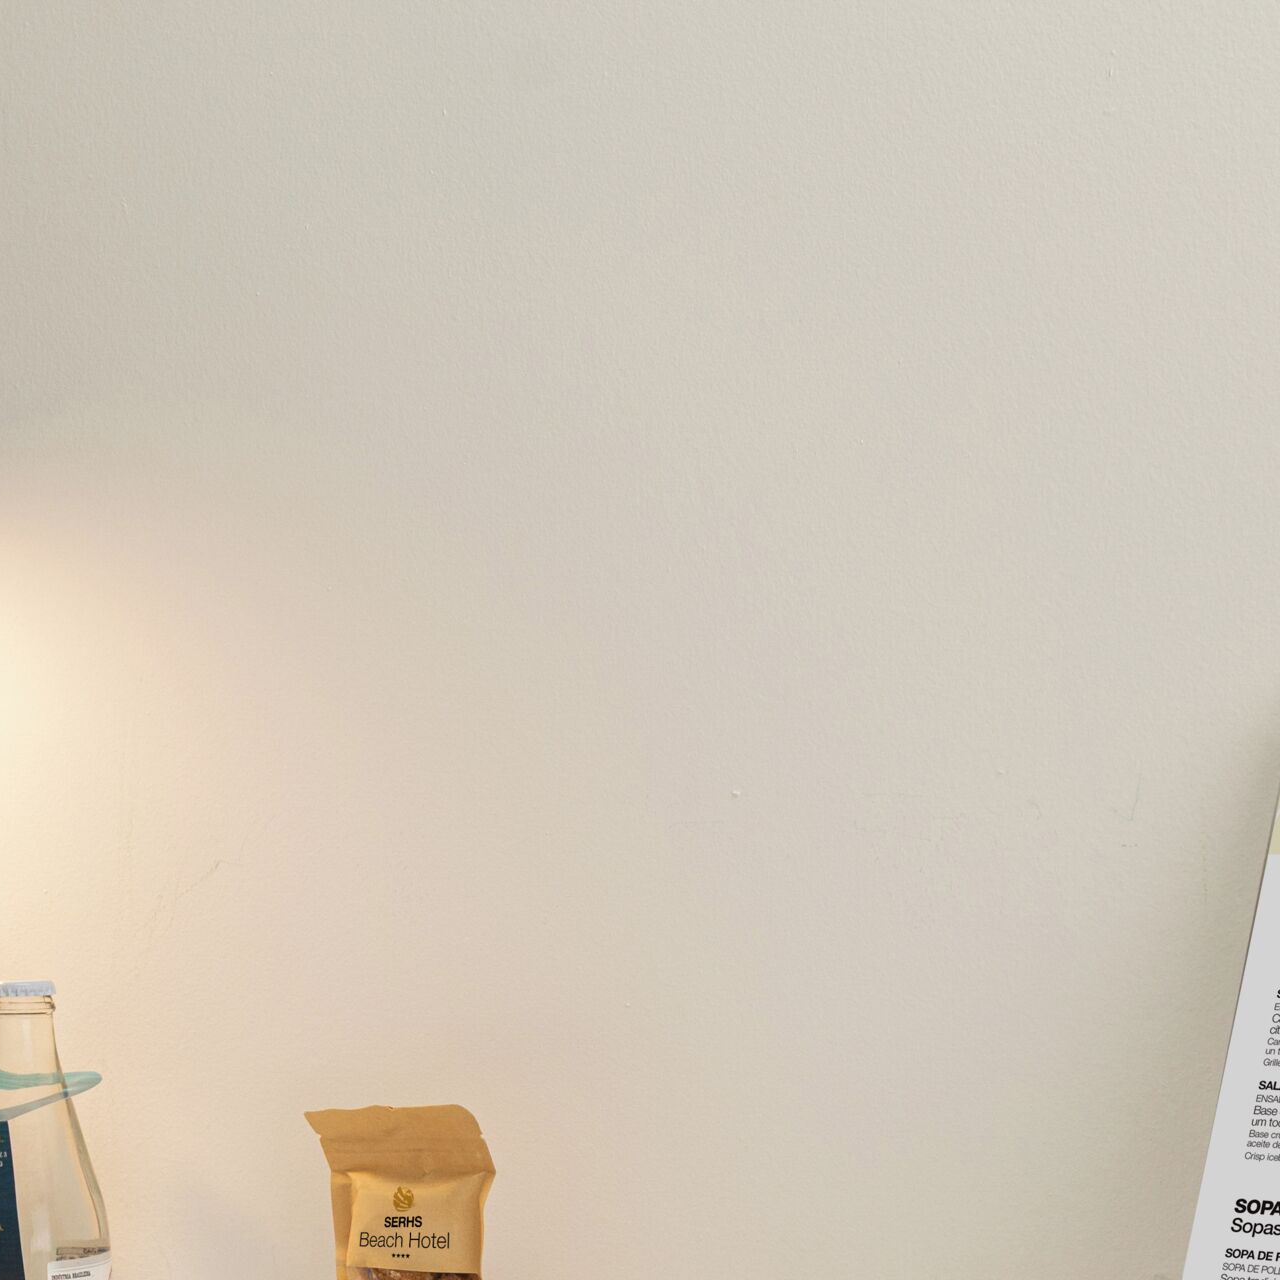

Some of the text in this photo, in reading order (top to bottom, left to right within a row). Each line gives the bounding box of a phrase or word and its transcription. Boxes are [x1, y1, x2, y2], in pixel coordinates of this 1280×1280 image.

[384, 1215, 422, 1227] SERHS
[359, 1231, 450, 1249] Beach Hotel
[1224, 1247, 1255, 1260] SOPA
[1256, 1250, 1274, 1262] DE
